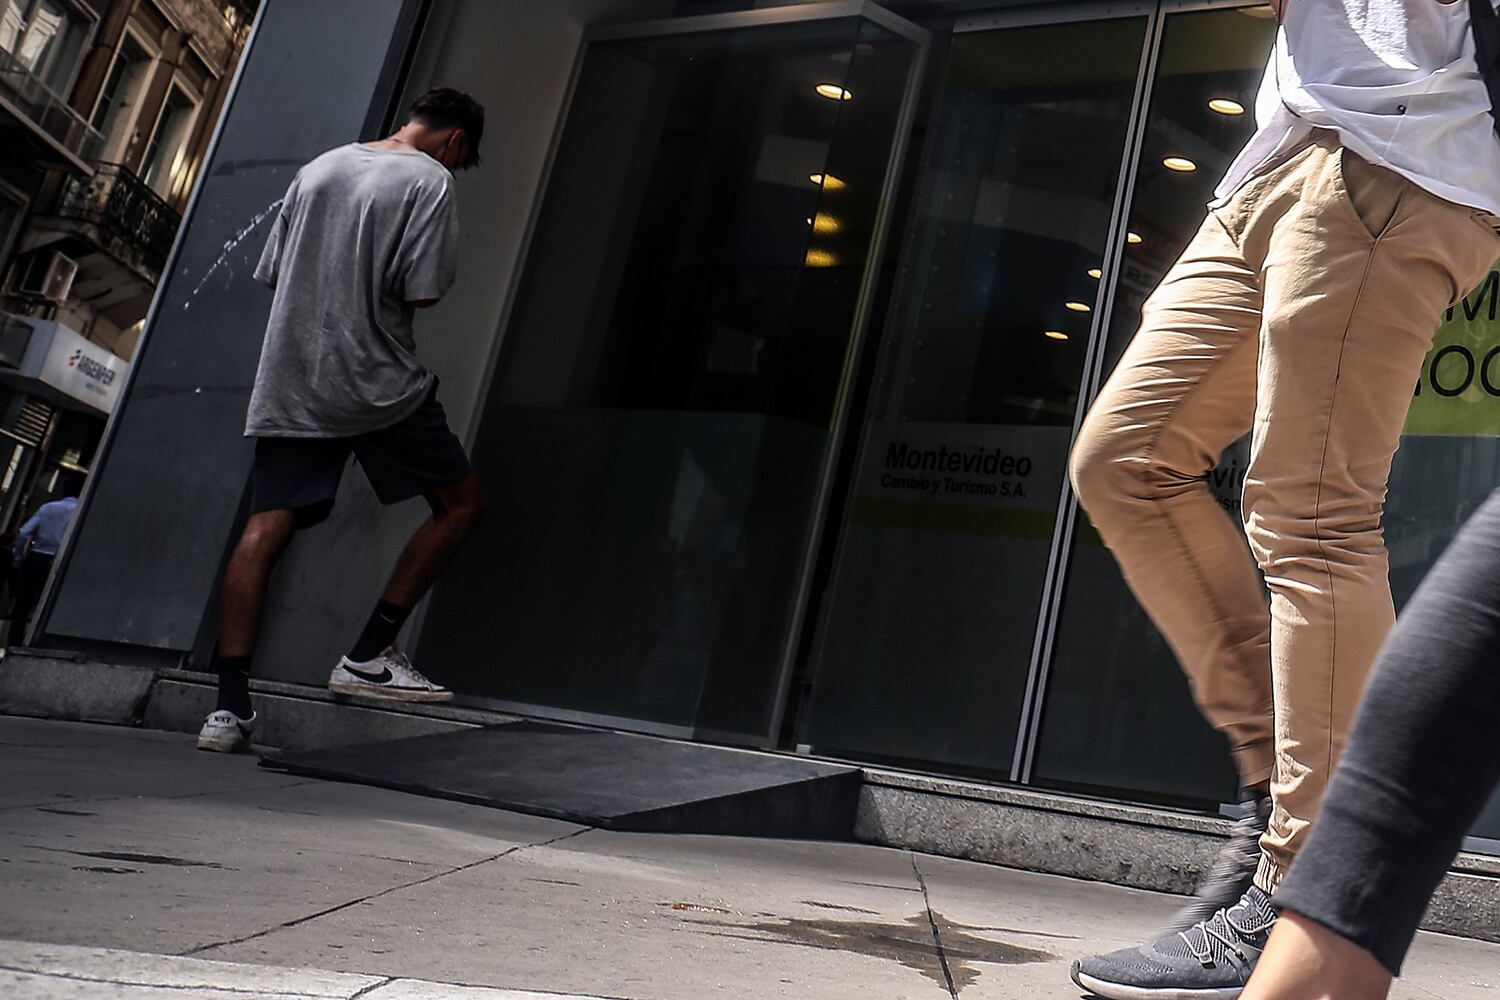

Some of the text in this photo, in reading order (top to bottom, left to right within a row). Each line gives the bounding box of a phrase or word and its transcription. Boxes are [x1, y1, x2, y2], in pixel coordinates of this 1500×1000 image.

[885, 442, 1032, 477] Montevideo
[881, 473, 1027, 498] Cambio y Turismo S.A.
